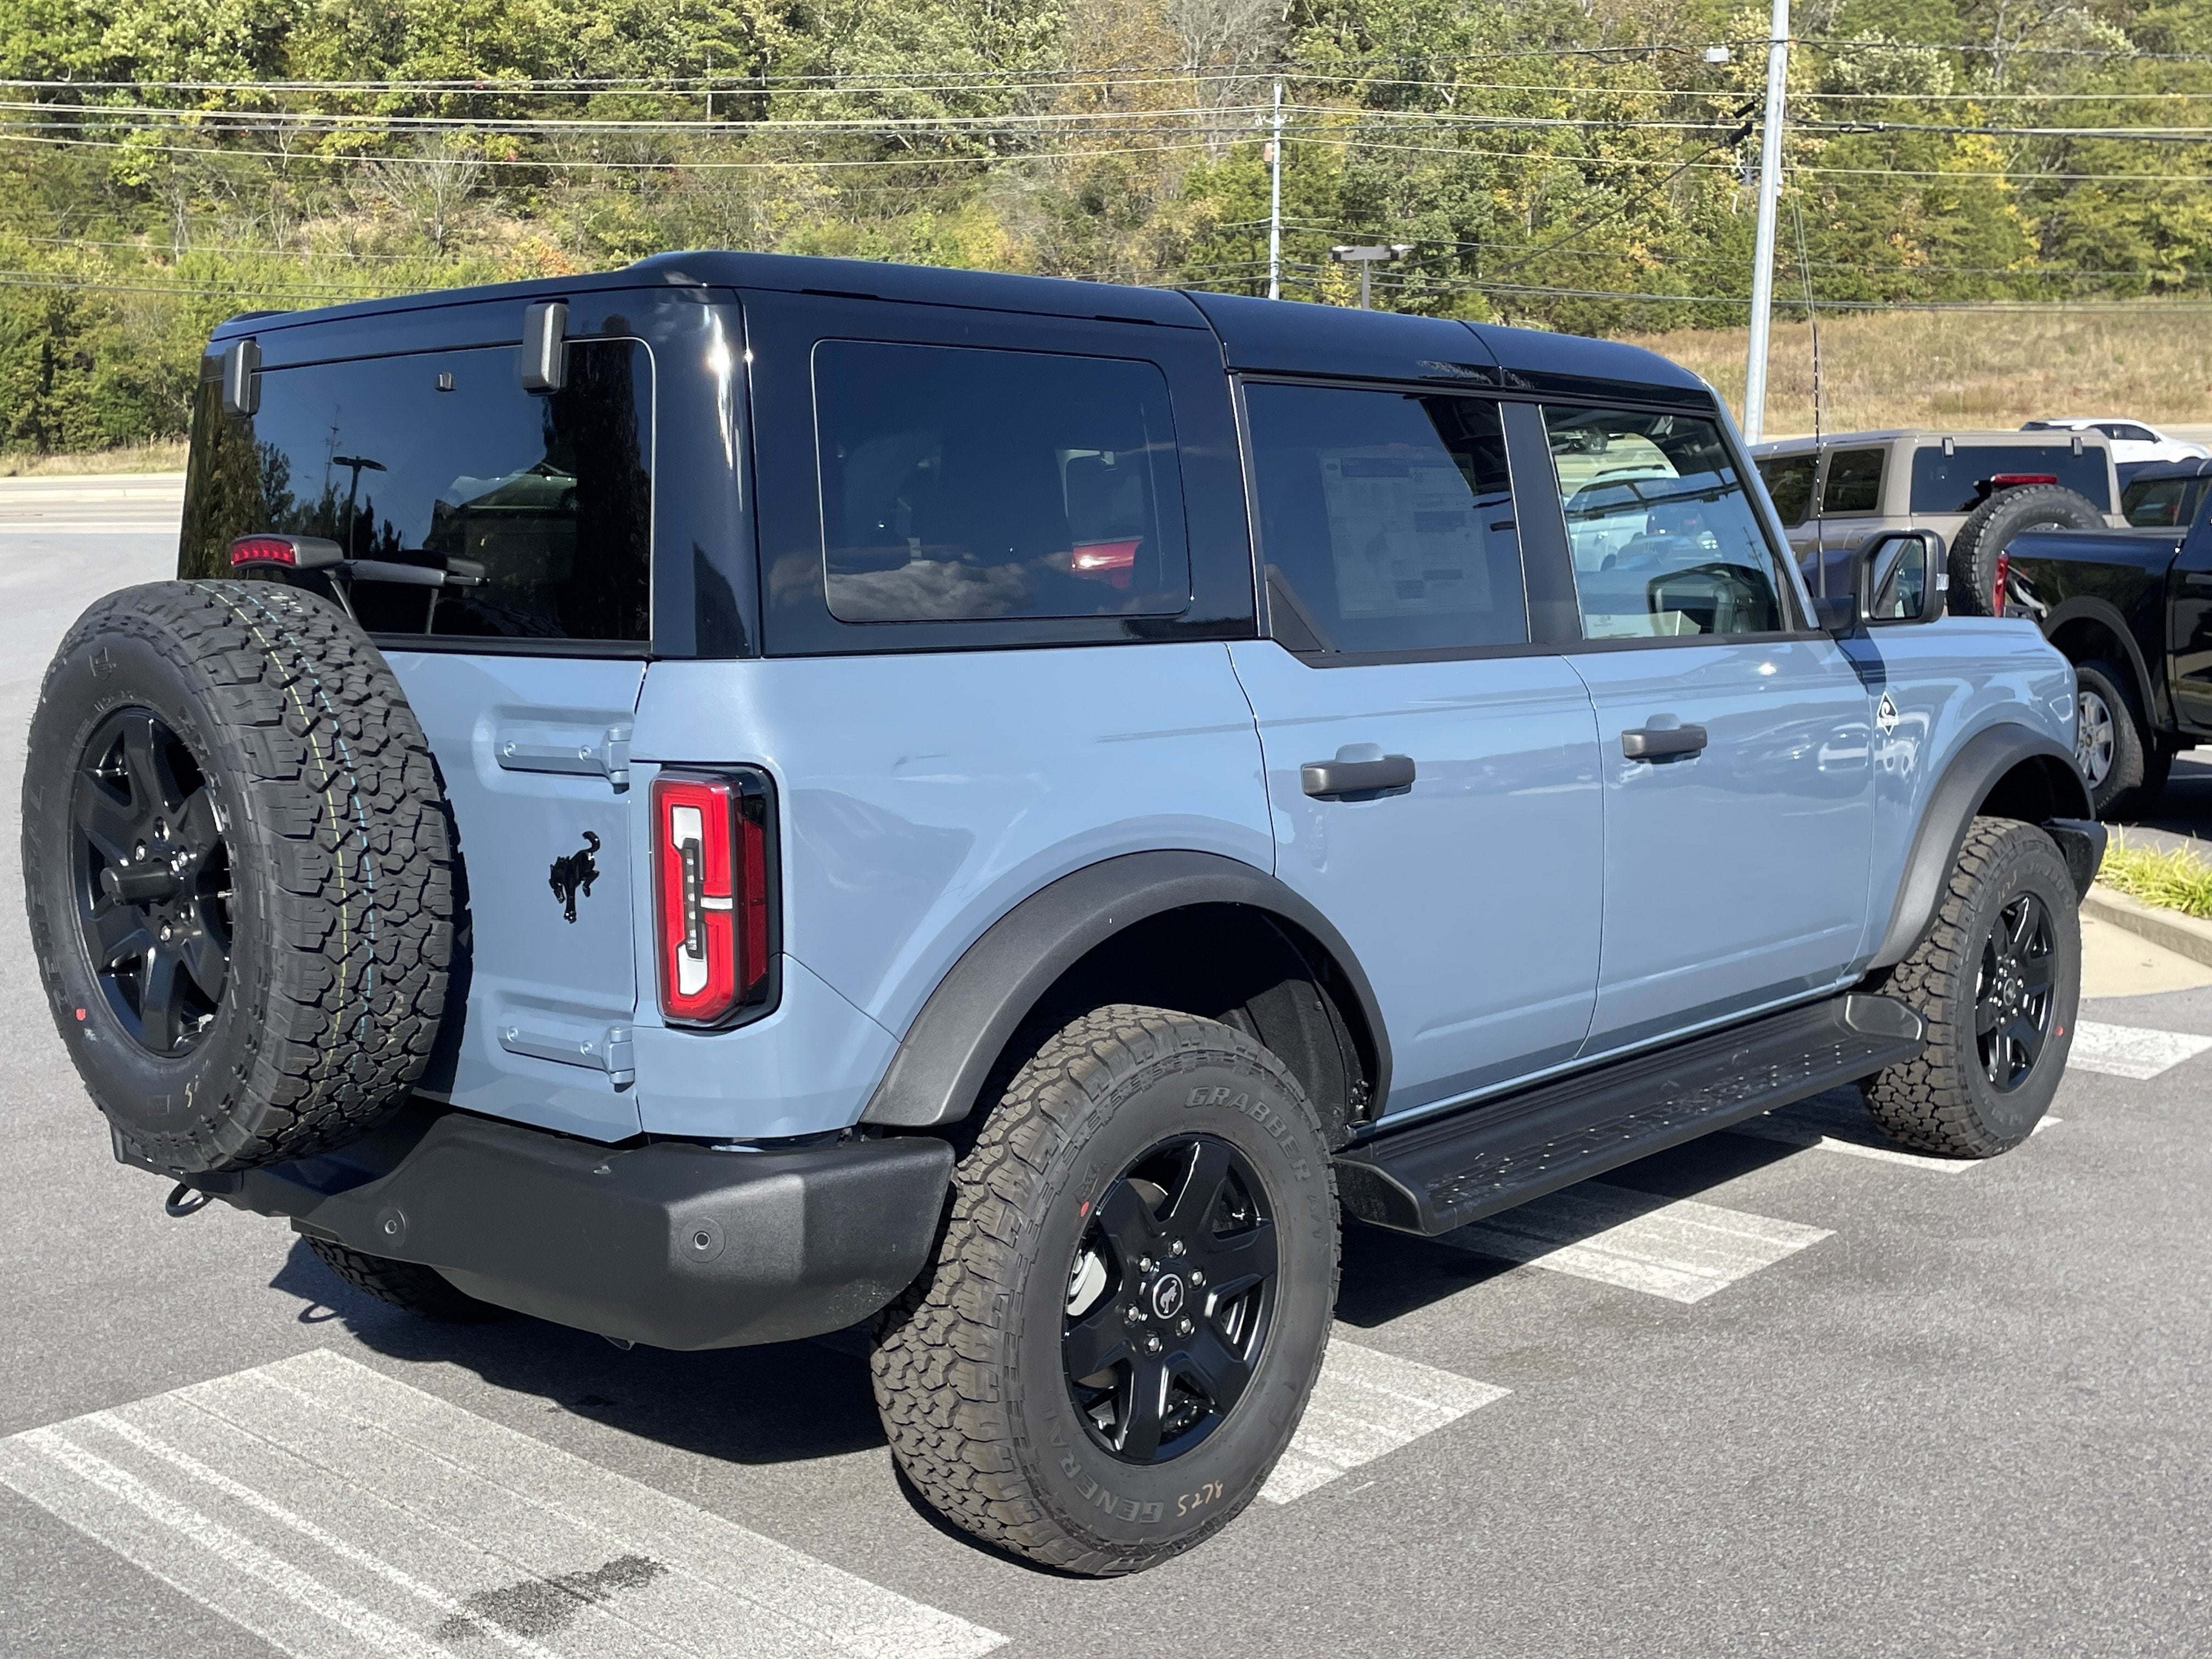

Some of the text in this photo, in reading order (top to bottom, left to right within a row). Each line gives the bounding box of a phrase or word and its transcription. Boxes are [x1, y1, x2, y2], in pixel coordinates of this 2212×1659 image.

[1184, 1085, 1312, 1182] GRABBER
[1041, 1408, 1164, 1523] GENERAL
[1176, 1480, 1223, 1517] 5278
